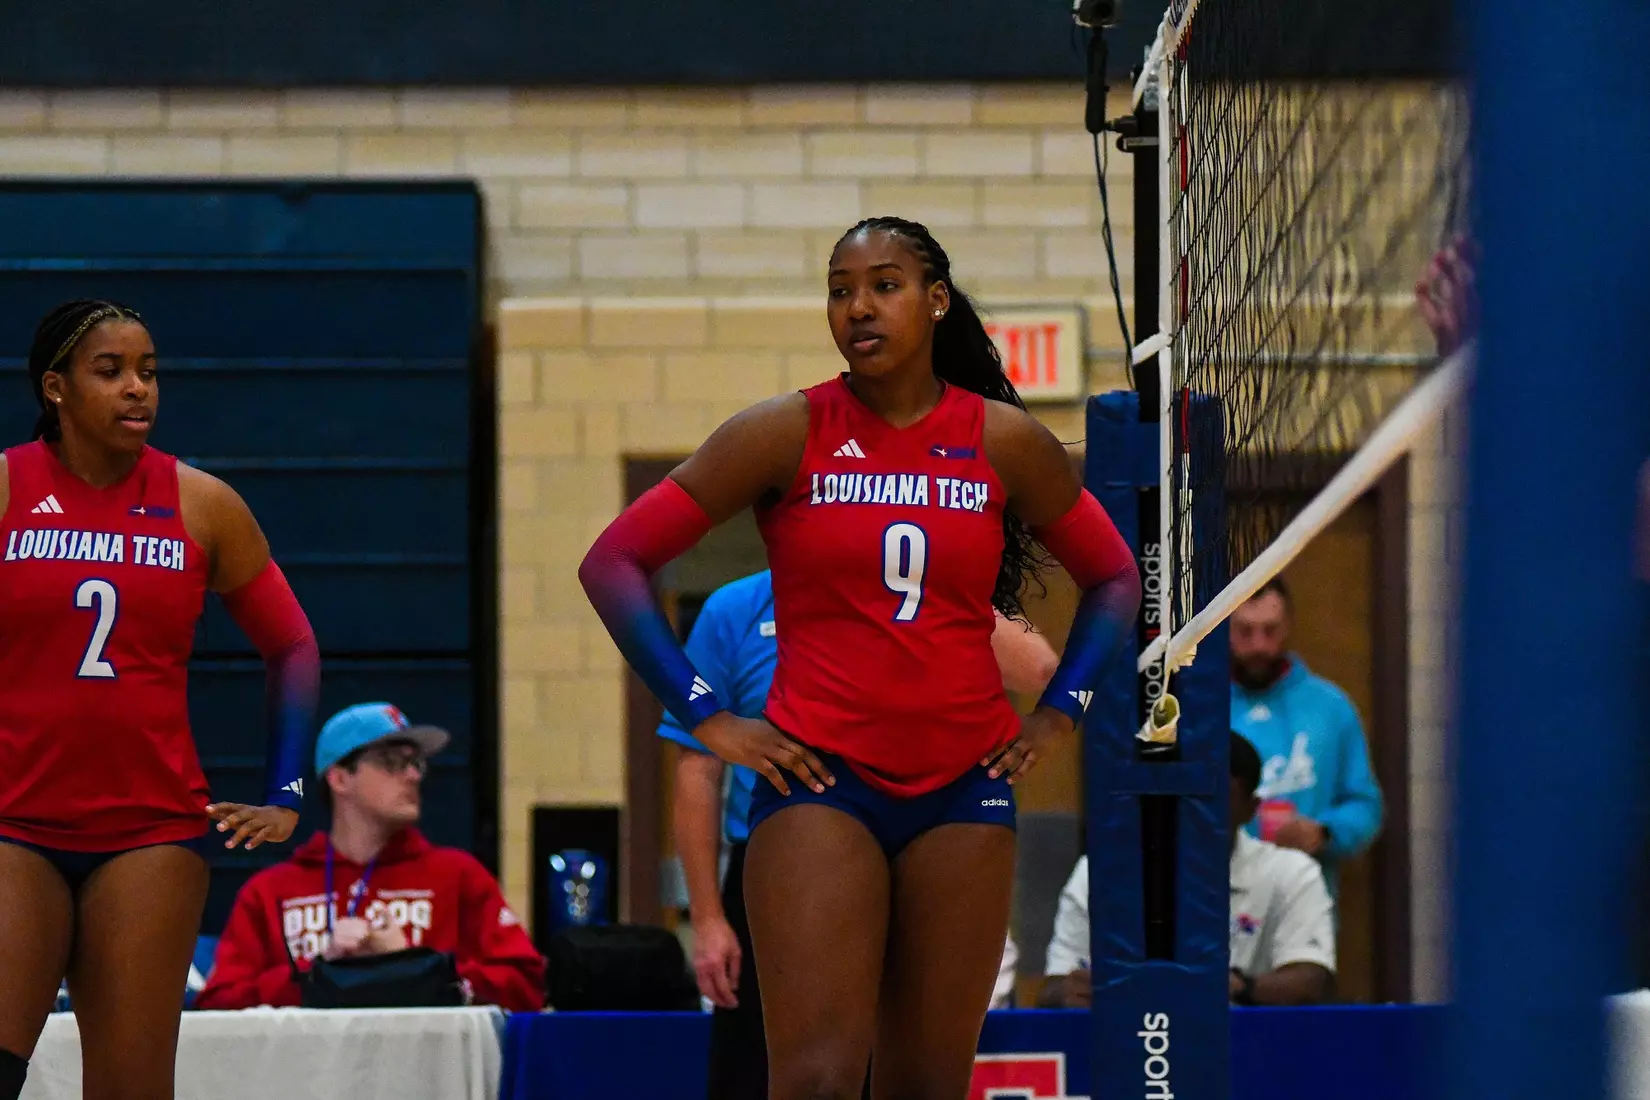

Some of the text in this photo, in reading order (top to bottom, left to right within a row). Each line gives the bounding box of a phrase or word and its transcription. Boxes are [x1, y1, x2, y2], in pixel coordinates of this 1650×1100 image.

[981, 323, 1062, 386] XIT
[810, 473, 989, 513] LOUISIANA TECH
[4, 529, 185, 571] LOUISIANA TECH
[883, 521, 927, 622] 9
[1141, 543, 1161, 624] sports
[75, 578, 118, 678] 2
[981, 798, 1009, 807] adidas
